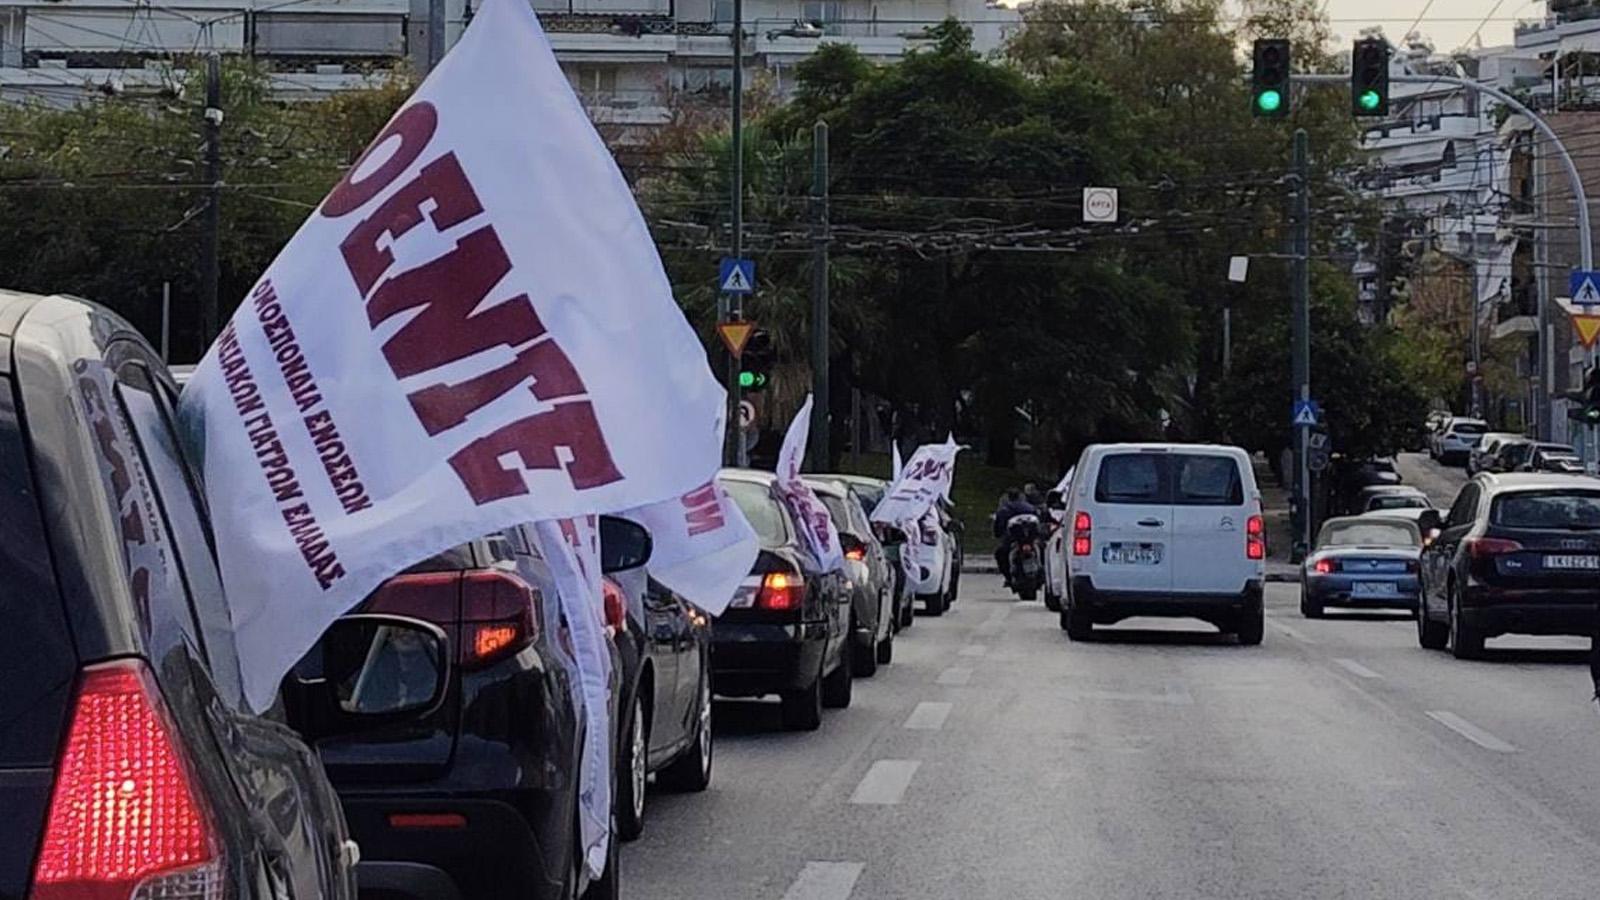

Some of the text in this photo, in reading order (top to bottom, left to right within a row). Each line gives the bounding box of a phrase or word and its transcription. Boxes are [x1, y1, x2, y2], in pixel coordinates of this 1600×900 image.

[319, 101, 626, 507] ΟΕΝΓΕ
[244, 411, 304, 502] ΓΙΑΤΡΩΝ
[282, 501, 346, 591] ΕΛΛΑΔΑΣ
[303, 410, 373, 515] ΕΝΩΣΕΩΝ
